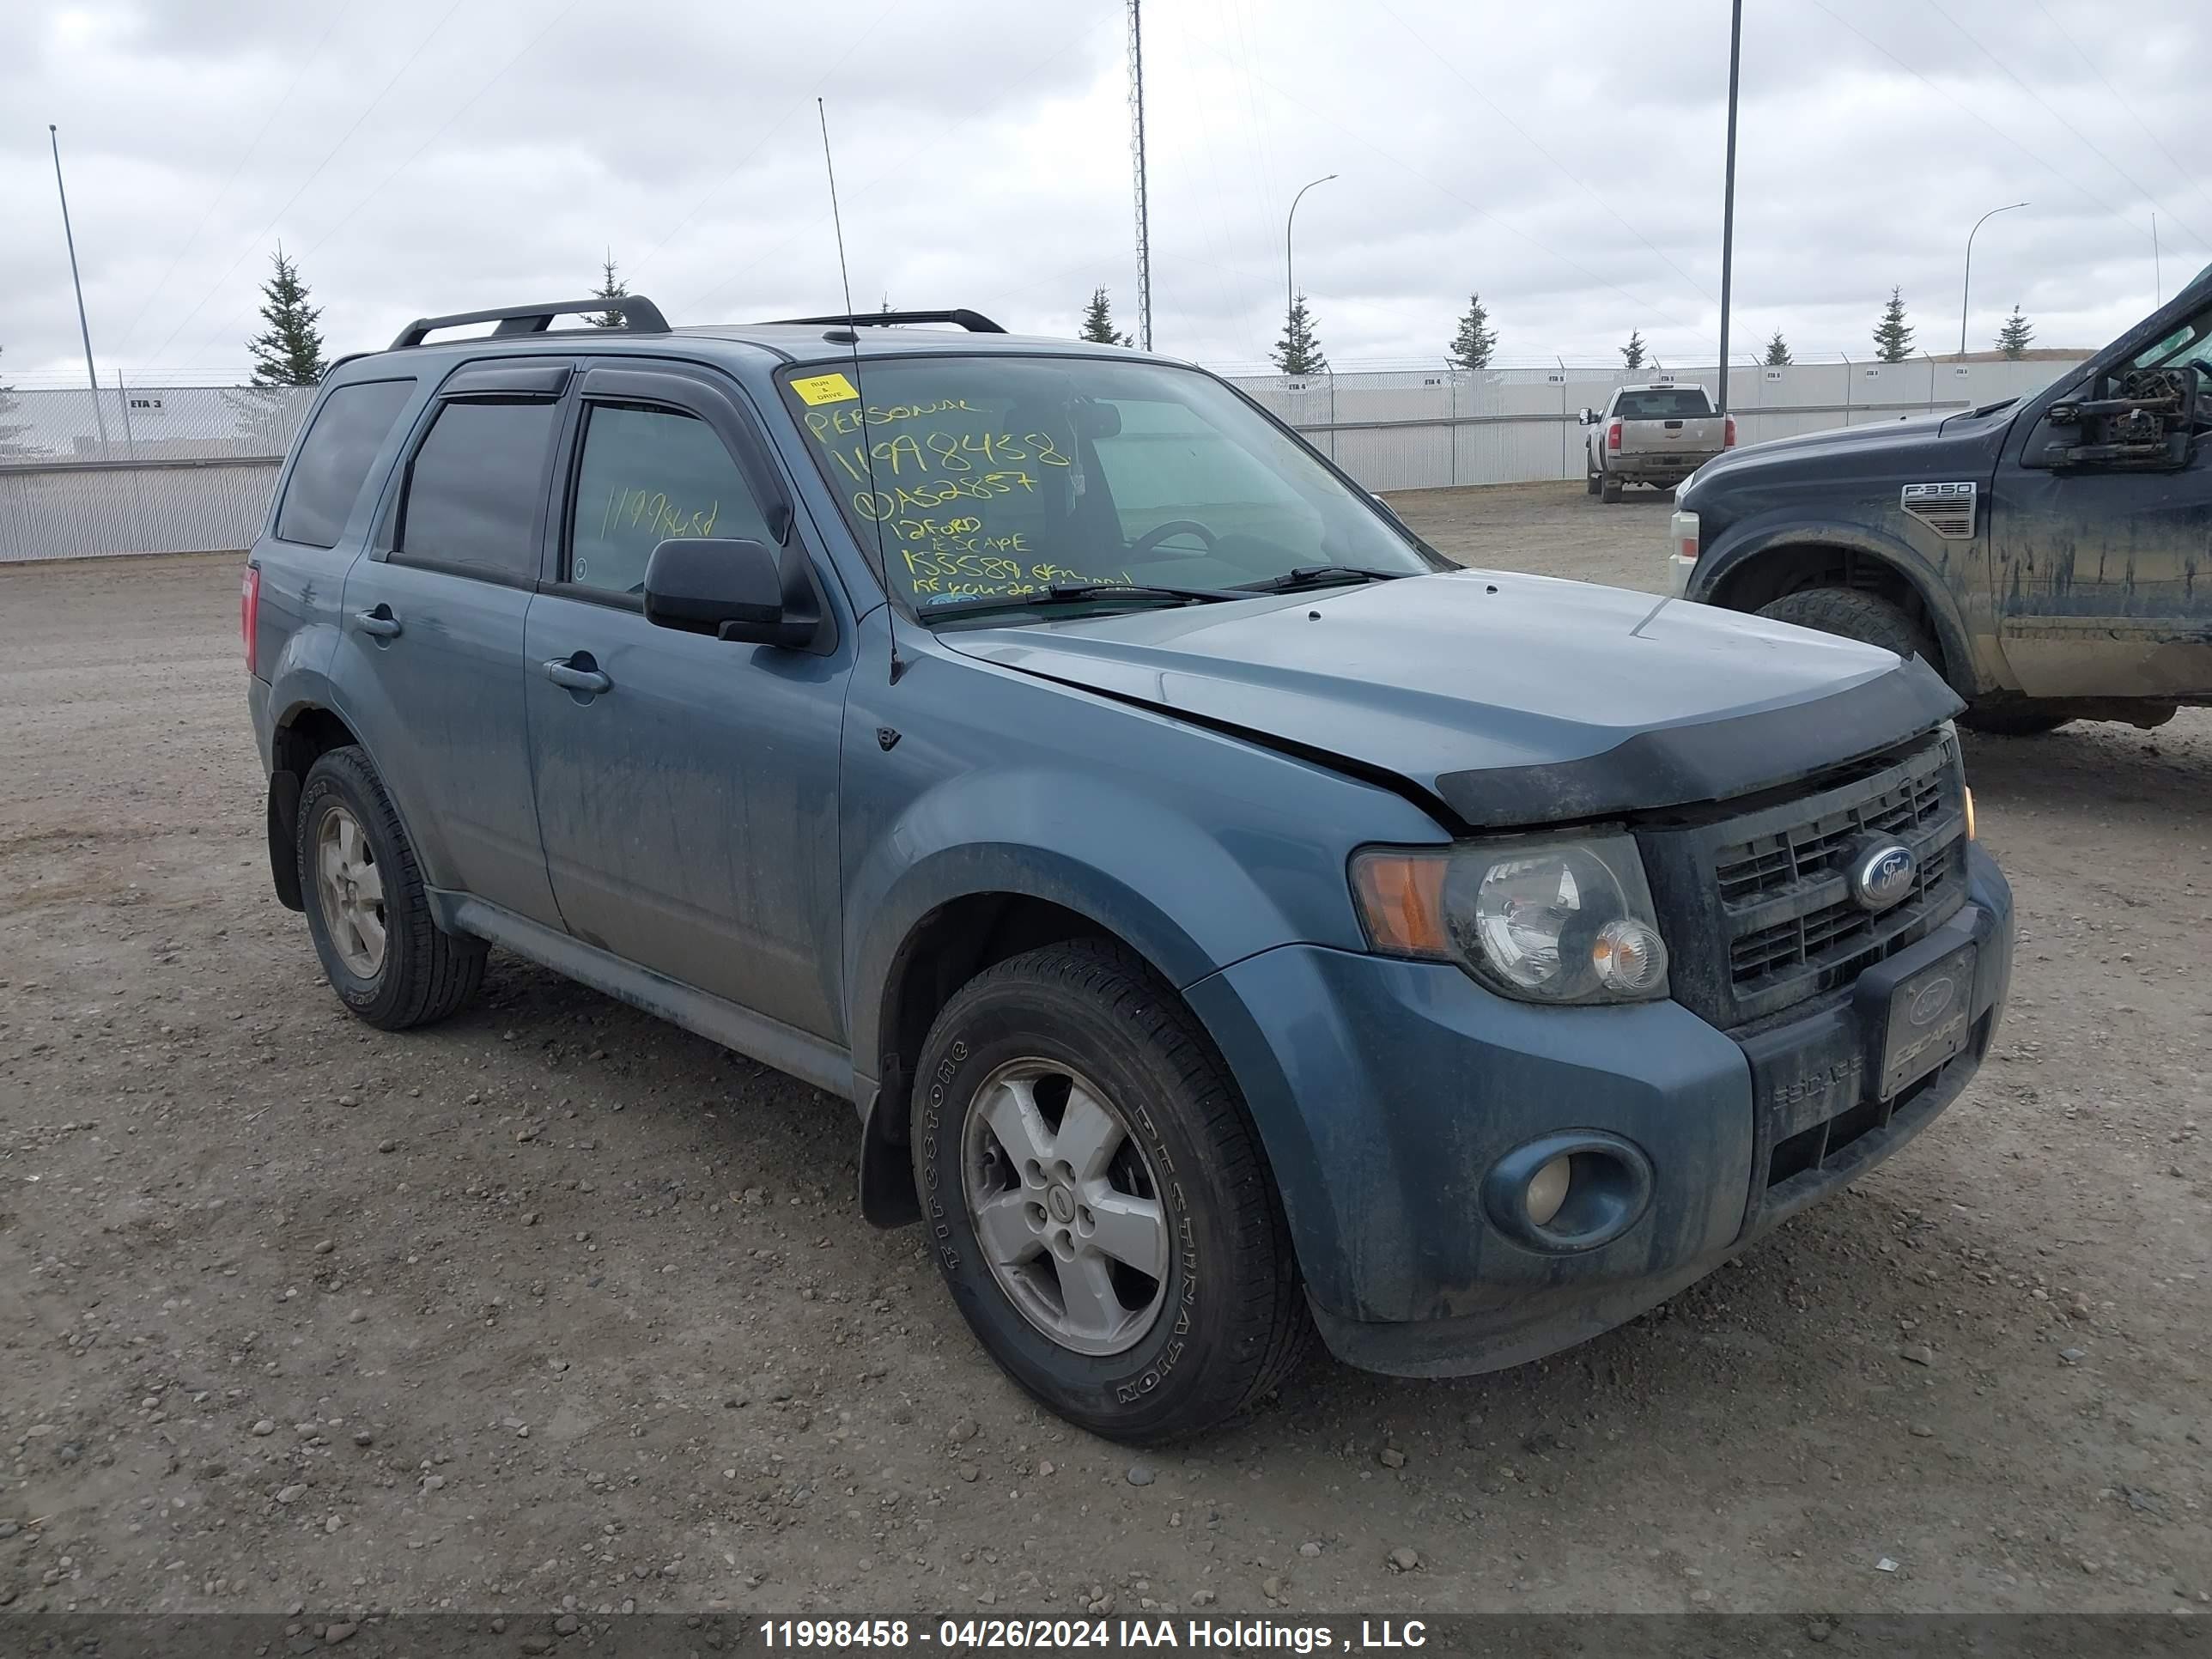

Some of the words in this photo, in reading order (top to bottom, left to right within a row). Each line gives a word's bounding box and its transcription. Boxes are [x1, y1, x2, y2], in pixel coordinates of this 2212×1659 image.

[130, 399, 151, 409] ETA
[153, 399, 161, 408] 3
[817, 392, 845, 400] DRIVE
[831, 431, 1071, 483] 11998458
[1905, 483, 1972, 495] F-350
[932, 533, 1034, 552] ESCAPE
[1889, 1012, 1966, 1072] ESCAPE
[1772, 1056, 1863, 1111] ESCAPE
[923, 1041, 969, 1269] Firestone
[1116, 1104, 1198, 1405] DESTINATION
